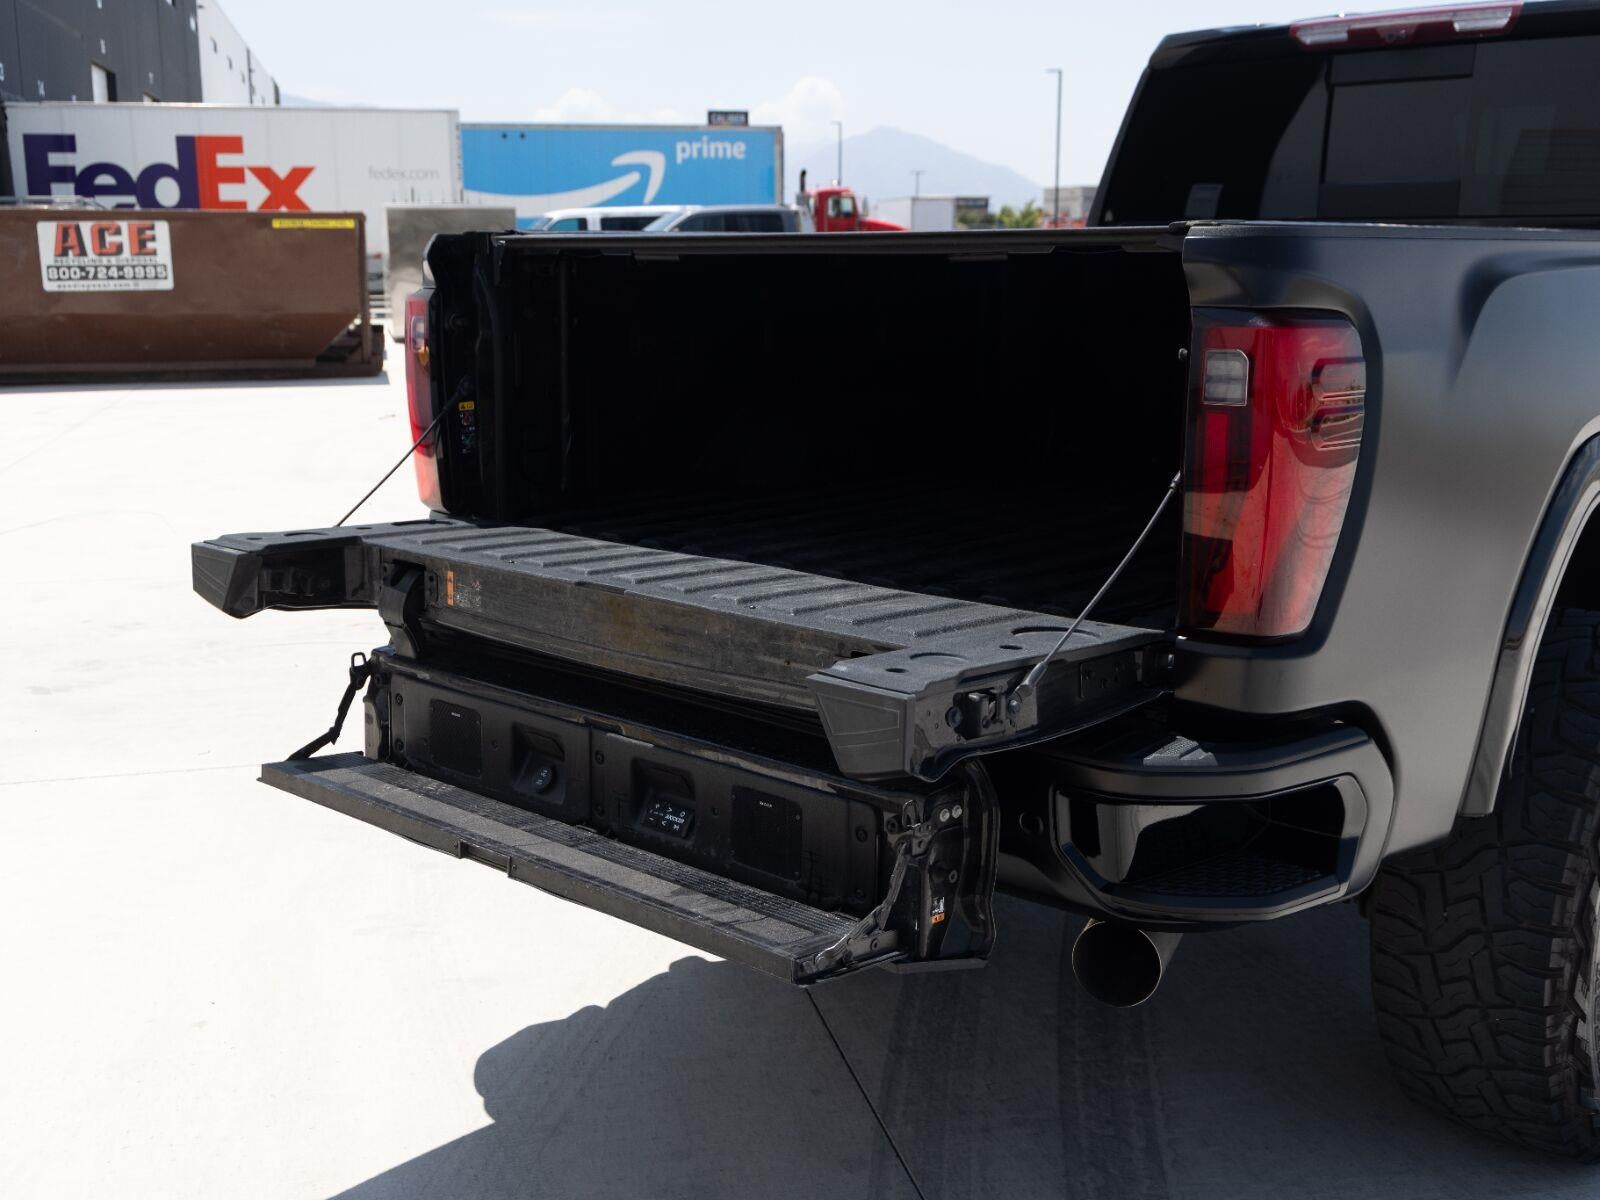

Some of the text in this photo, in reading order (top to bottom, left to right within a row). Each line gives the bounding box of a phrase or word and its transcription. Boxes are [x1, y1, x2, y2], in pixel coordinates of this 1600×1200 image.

[676, 135, 746, 165] prime
[22, 133, 316, 211] FedEx
[367, 164, 441, 181] fedex.com
[54, 223, 158, 257] ACE
